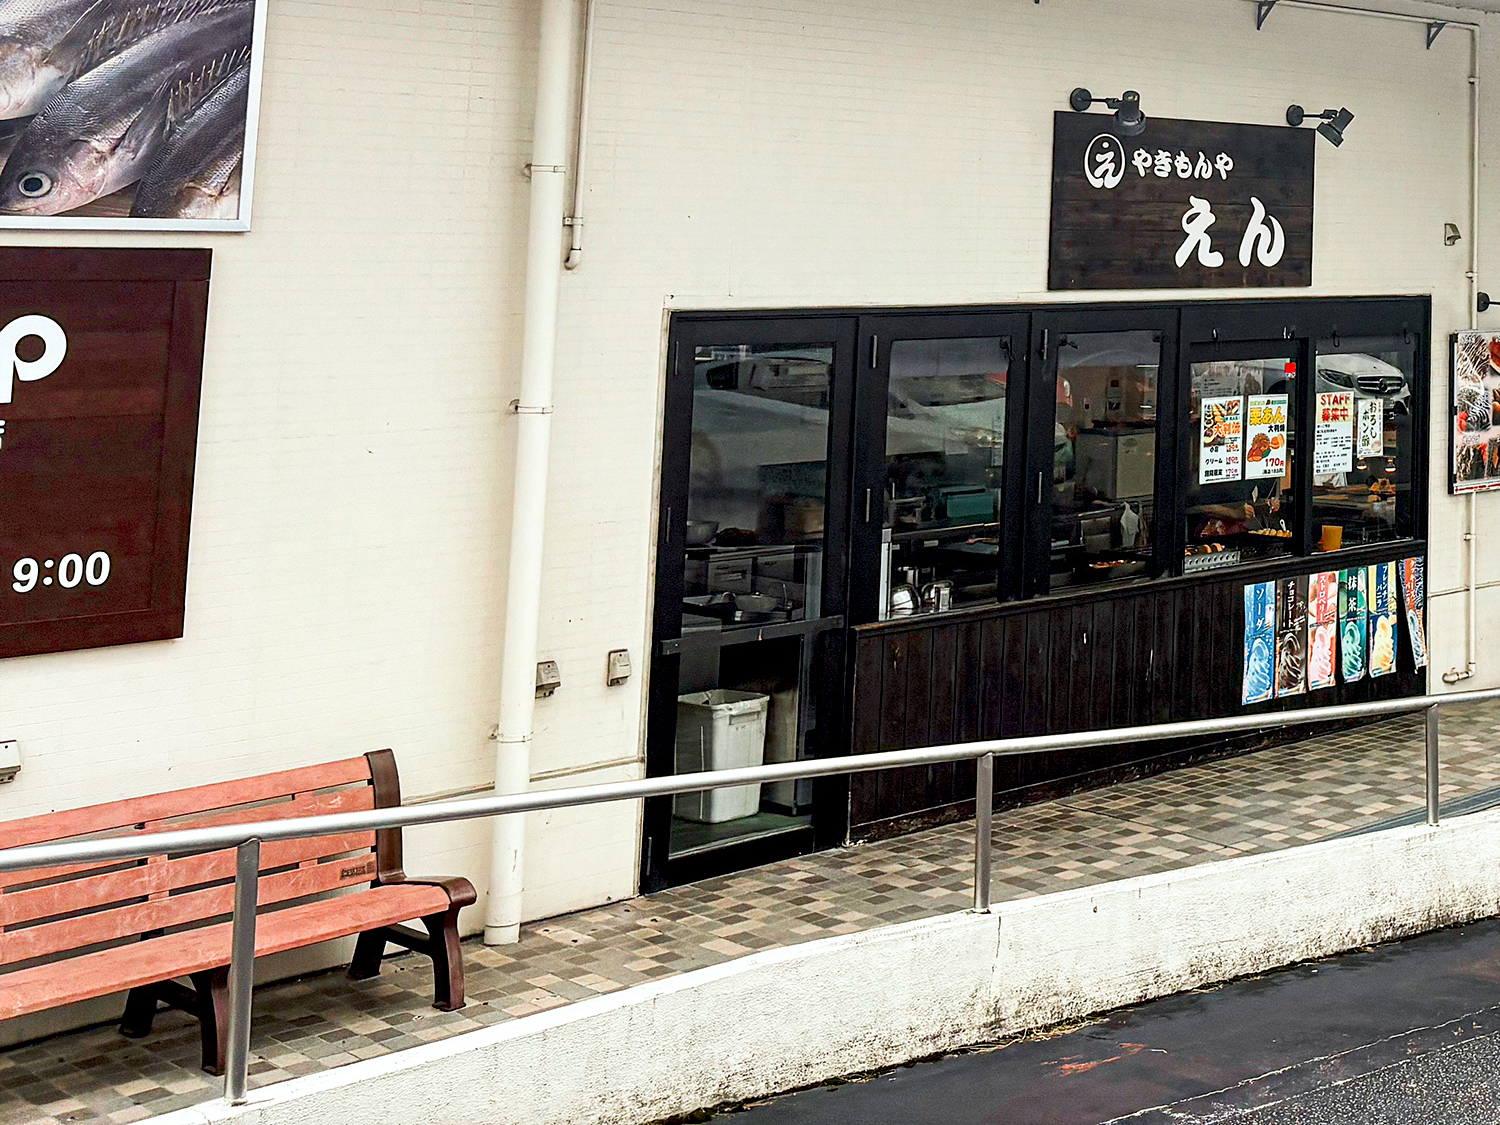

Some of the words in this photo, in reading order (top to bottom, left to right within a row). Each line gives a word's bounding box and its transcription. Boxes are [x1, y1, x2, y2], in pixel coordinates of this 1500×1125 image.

[1132, 147, 1234, 181] やきもんや
[1174, 195, 1285, 268] えん
[1249, 405, 1286, 425] 栗あん
[1320, 394, 1350, 406] STAFF
[1369, 401, 1377, 439] おろし
[12, 551, 111, 593] 9:00
[1255, 588, 1266, 631] ソーダ
[1287, 580, 1296, 629] チョコレート
[1319, 575, 1328, 623] ストロベリー
[1348, 576, 1358, 613] 抹茶
